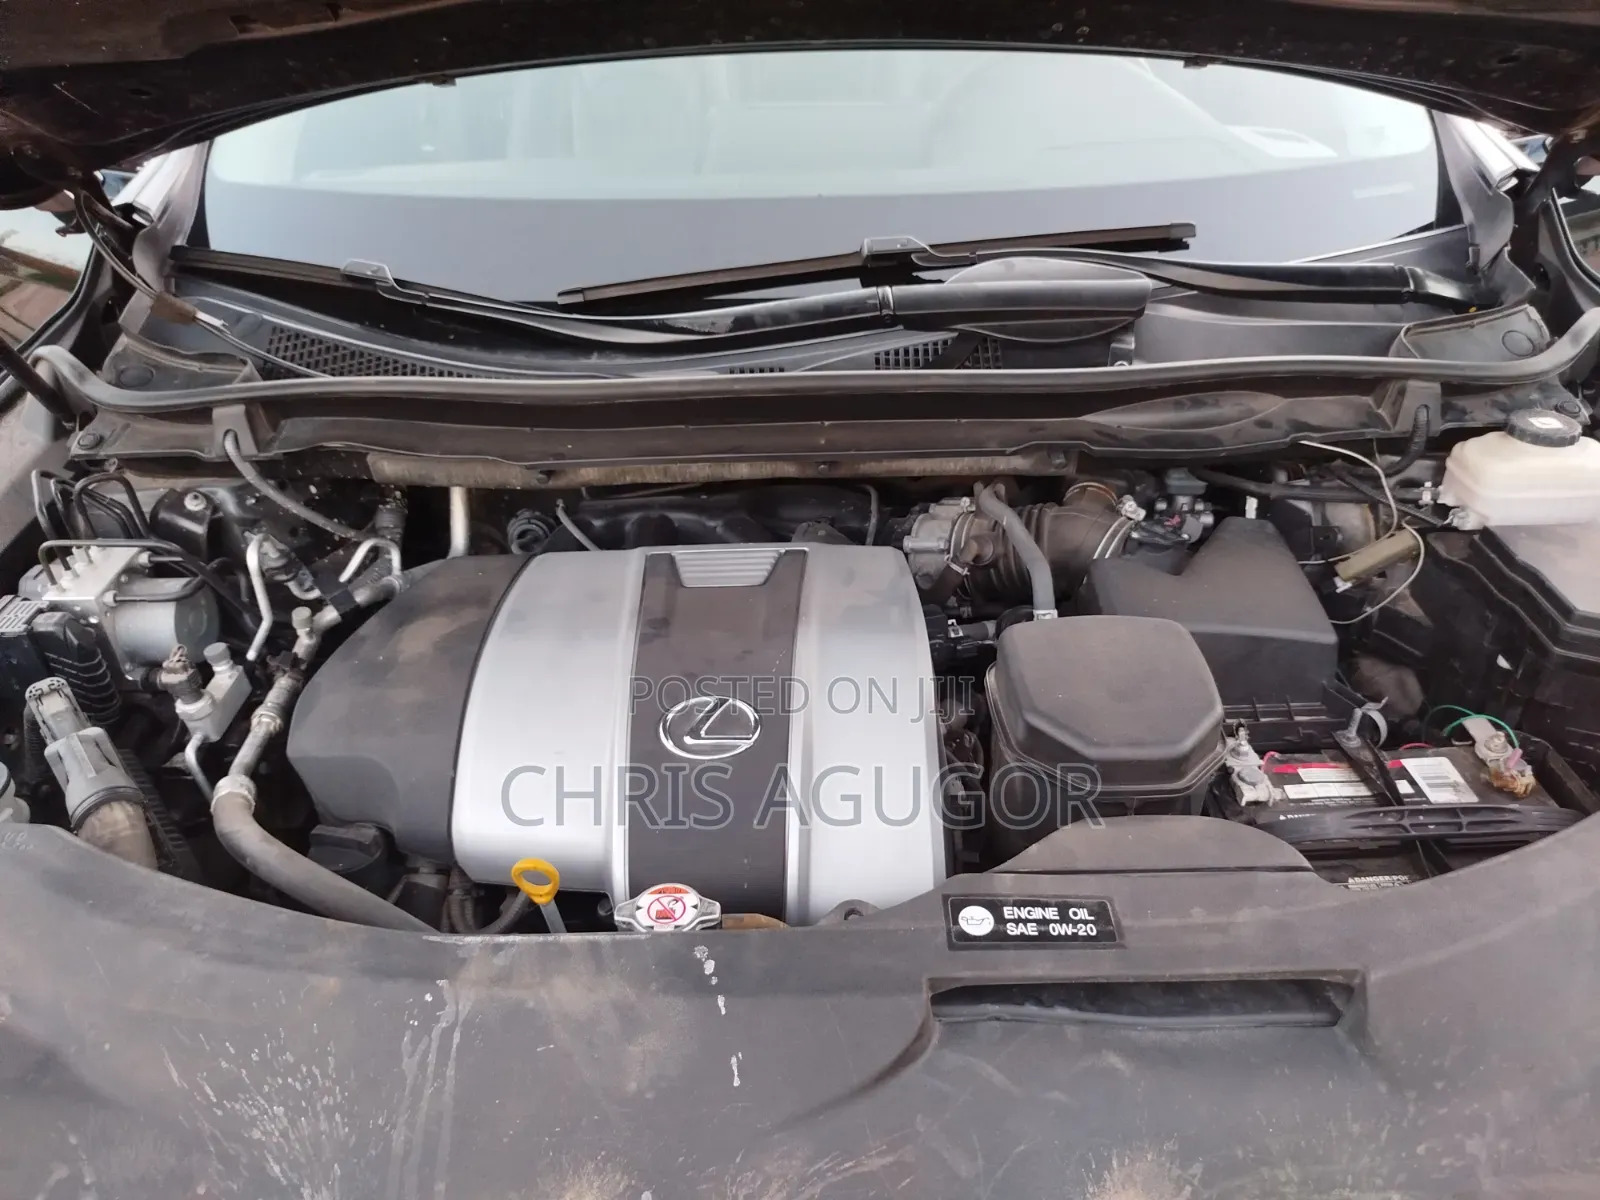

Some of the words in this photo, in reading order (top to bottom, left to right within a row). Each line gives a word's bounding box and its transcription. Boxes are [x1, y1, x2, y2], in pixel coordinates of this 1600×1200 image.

[1003, 906, 1060, 920] ENGINE
[1068, 907, 1095, 920] OIL
[1006, 922, 1039, 936] SAE
[1049, 923, 1097, 936] 0W-20
